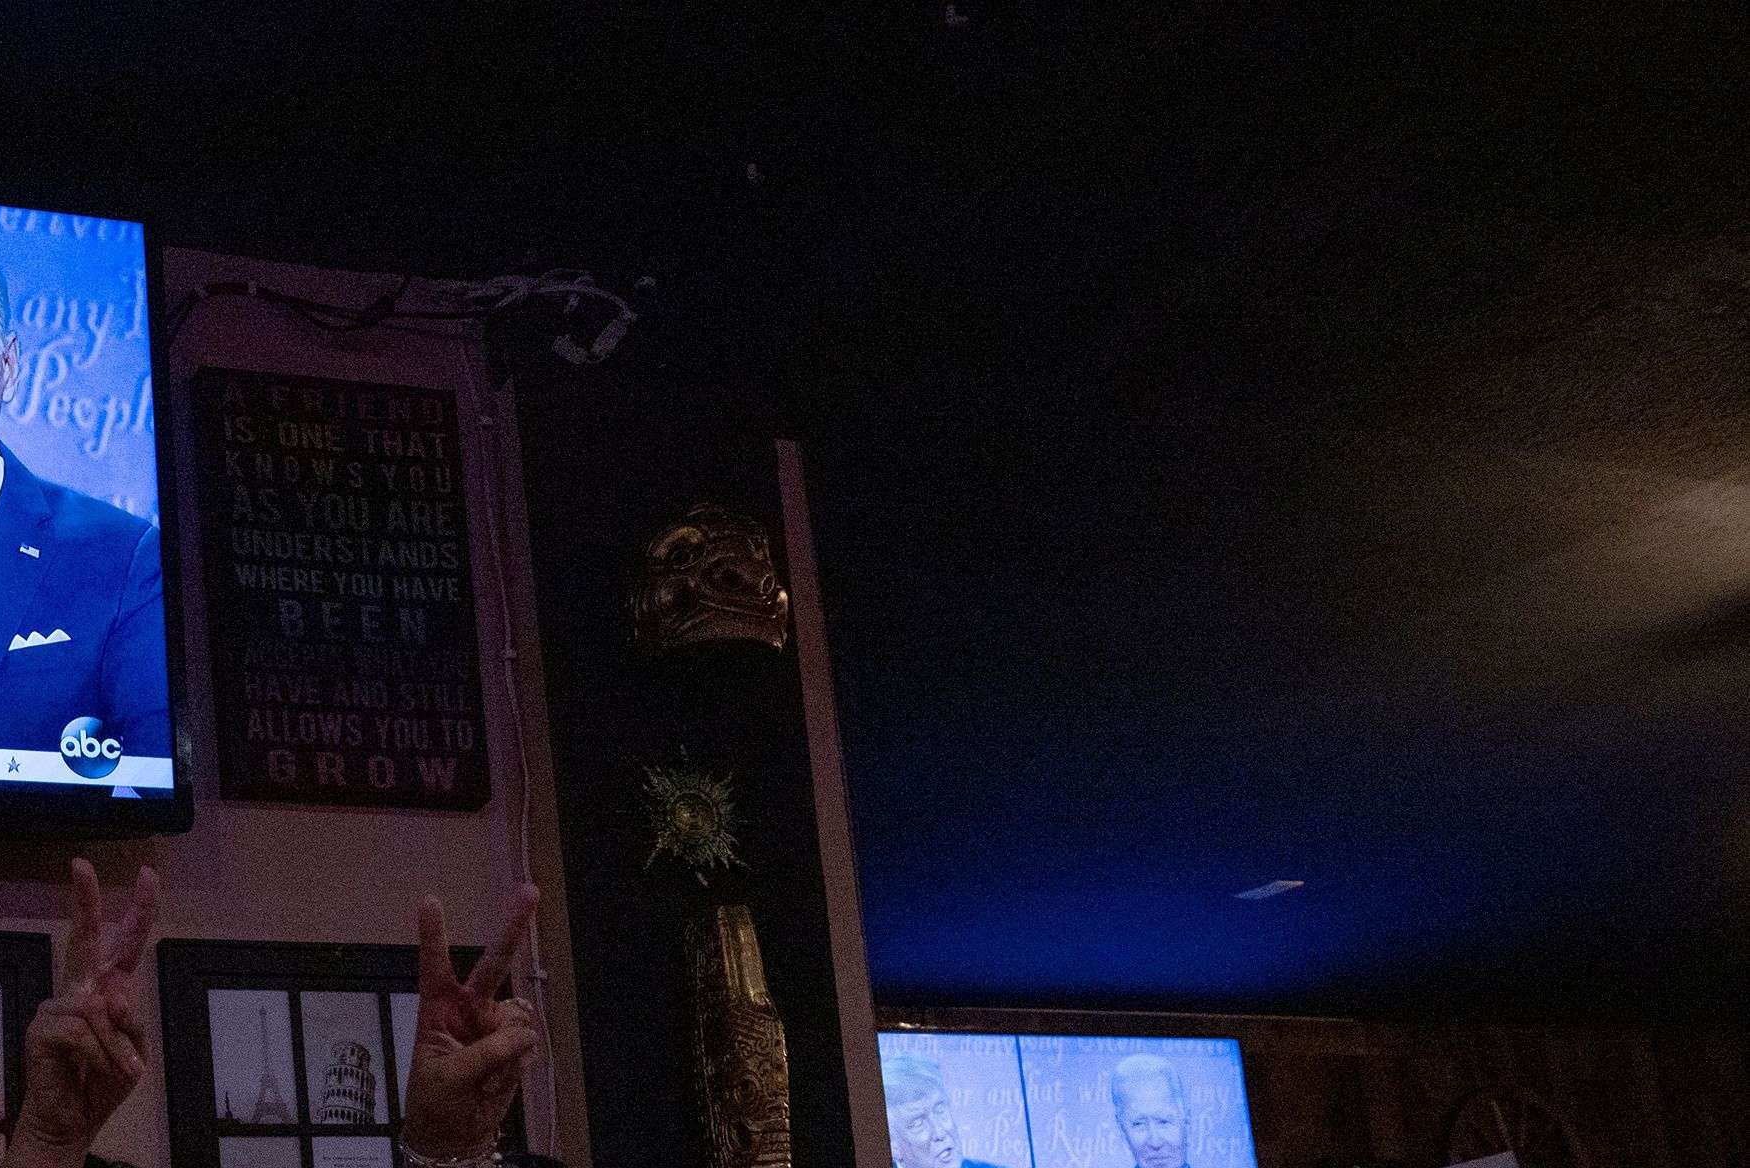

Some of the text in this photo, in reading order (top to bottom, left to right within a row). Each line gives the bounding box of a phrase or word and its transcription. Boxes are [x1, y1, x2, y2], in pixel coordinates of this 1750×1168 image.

[224, 415, 447, 459] IS ONE THAT
[225, 450, 453, 495] KNOWS YOU
[232, 484, 457, 537] AS YOU ARE
[232, 528, 459, 569] UNDERSTANDS
[234, 563, 461, 602] WHERE YOU HAVE
[279, 598, 428, 645] BEEN
[245, 674, 322, 705] HAVE
[333, 679, 389, 708] AND
[59, 729, 122, 759] abc
[247, 706, 474, 750] ALLOWS YOU TO
[267, 748, 459, 792] GROW
